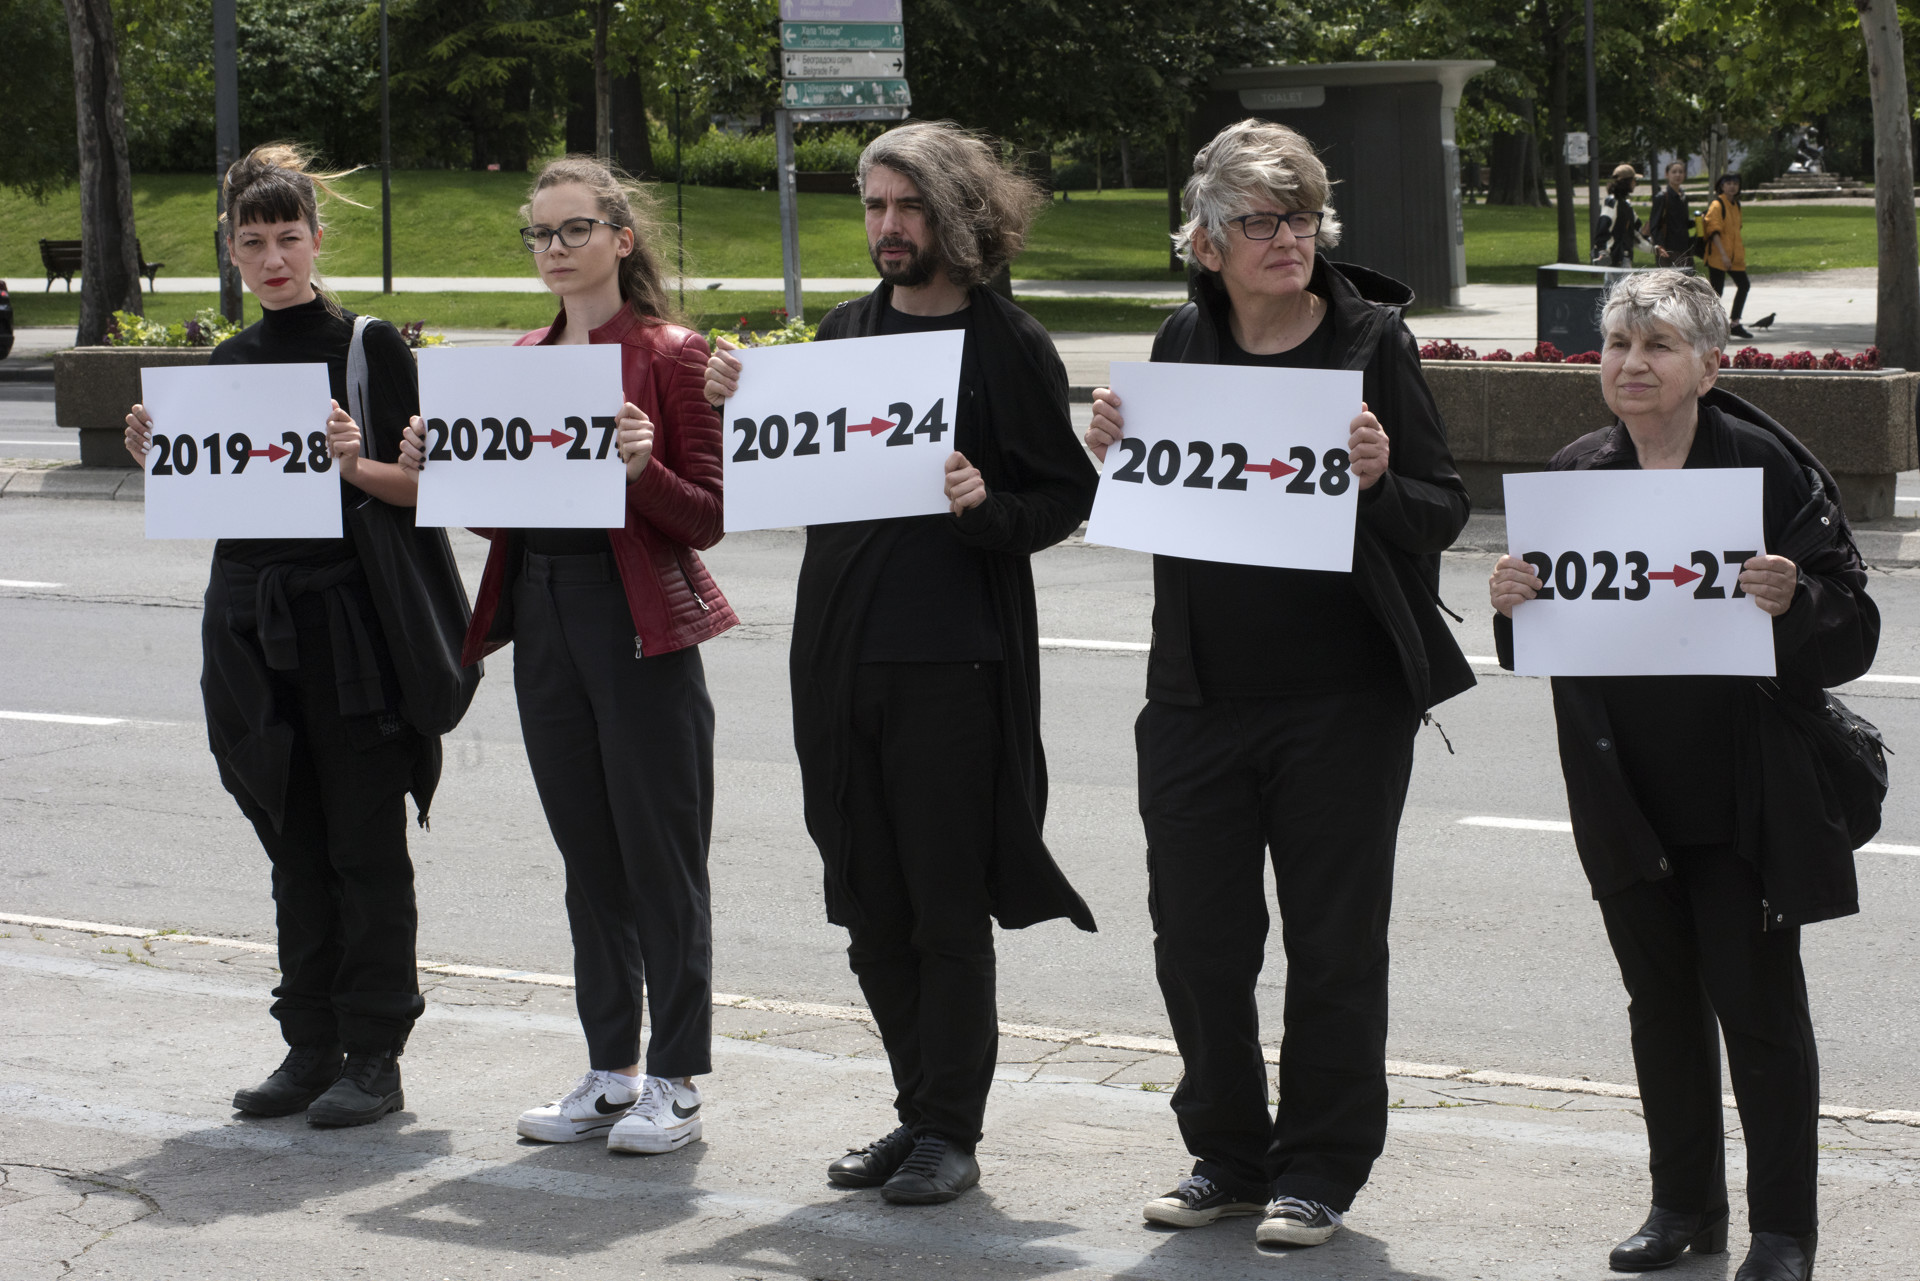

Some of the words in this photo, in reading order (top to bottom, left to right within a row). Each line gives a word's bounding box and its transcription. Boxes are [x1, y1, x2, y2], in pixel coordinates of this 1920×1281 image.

[803, 66, 828, 78] Belgrade
[829, 66, 841, 76] Fair
[1261, 92, 1303, 104] TOALET
[282, 431, 336, 474] 28
[427, 417, 534, 461] 2020
[564, 416, 618, 460] 27
[733, 407, 847, 463] 2021
[887, 398, 948, 447] 24
[1112, 437, 1248, 491] 2022
[1285, 446, 1352, 497] 28
[1522, 551, 1651, 601] 2023
